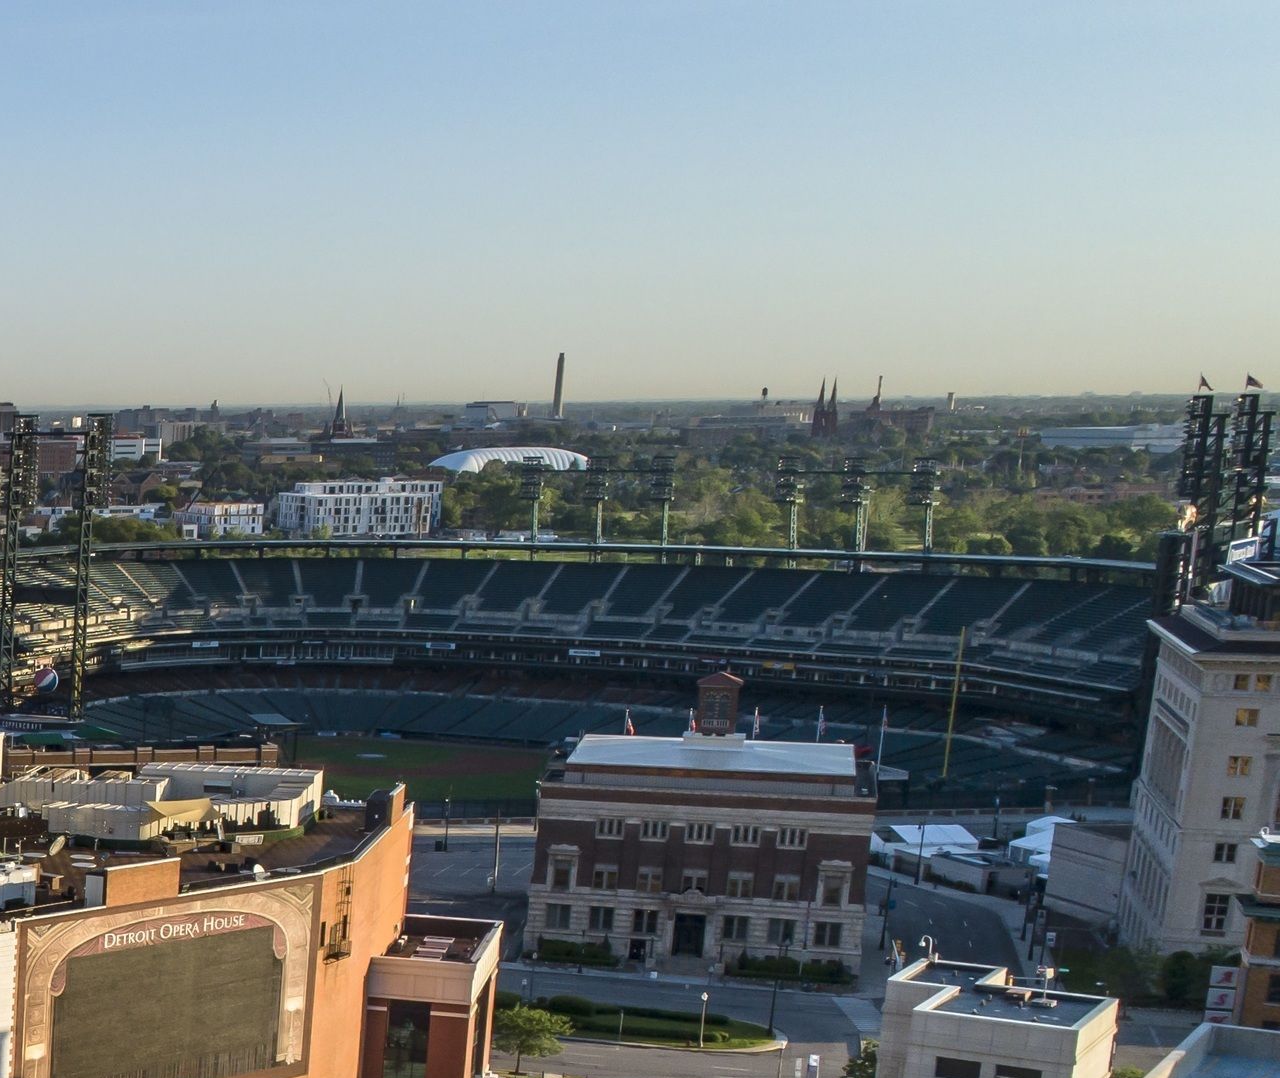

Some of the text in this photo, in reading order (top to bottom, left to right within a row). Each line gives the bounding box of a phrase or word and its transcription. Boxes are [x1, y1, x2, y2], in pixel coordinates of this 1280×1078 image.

[104, 914, 245, 949] DETROIT OPERA HOUSE
